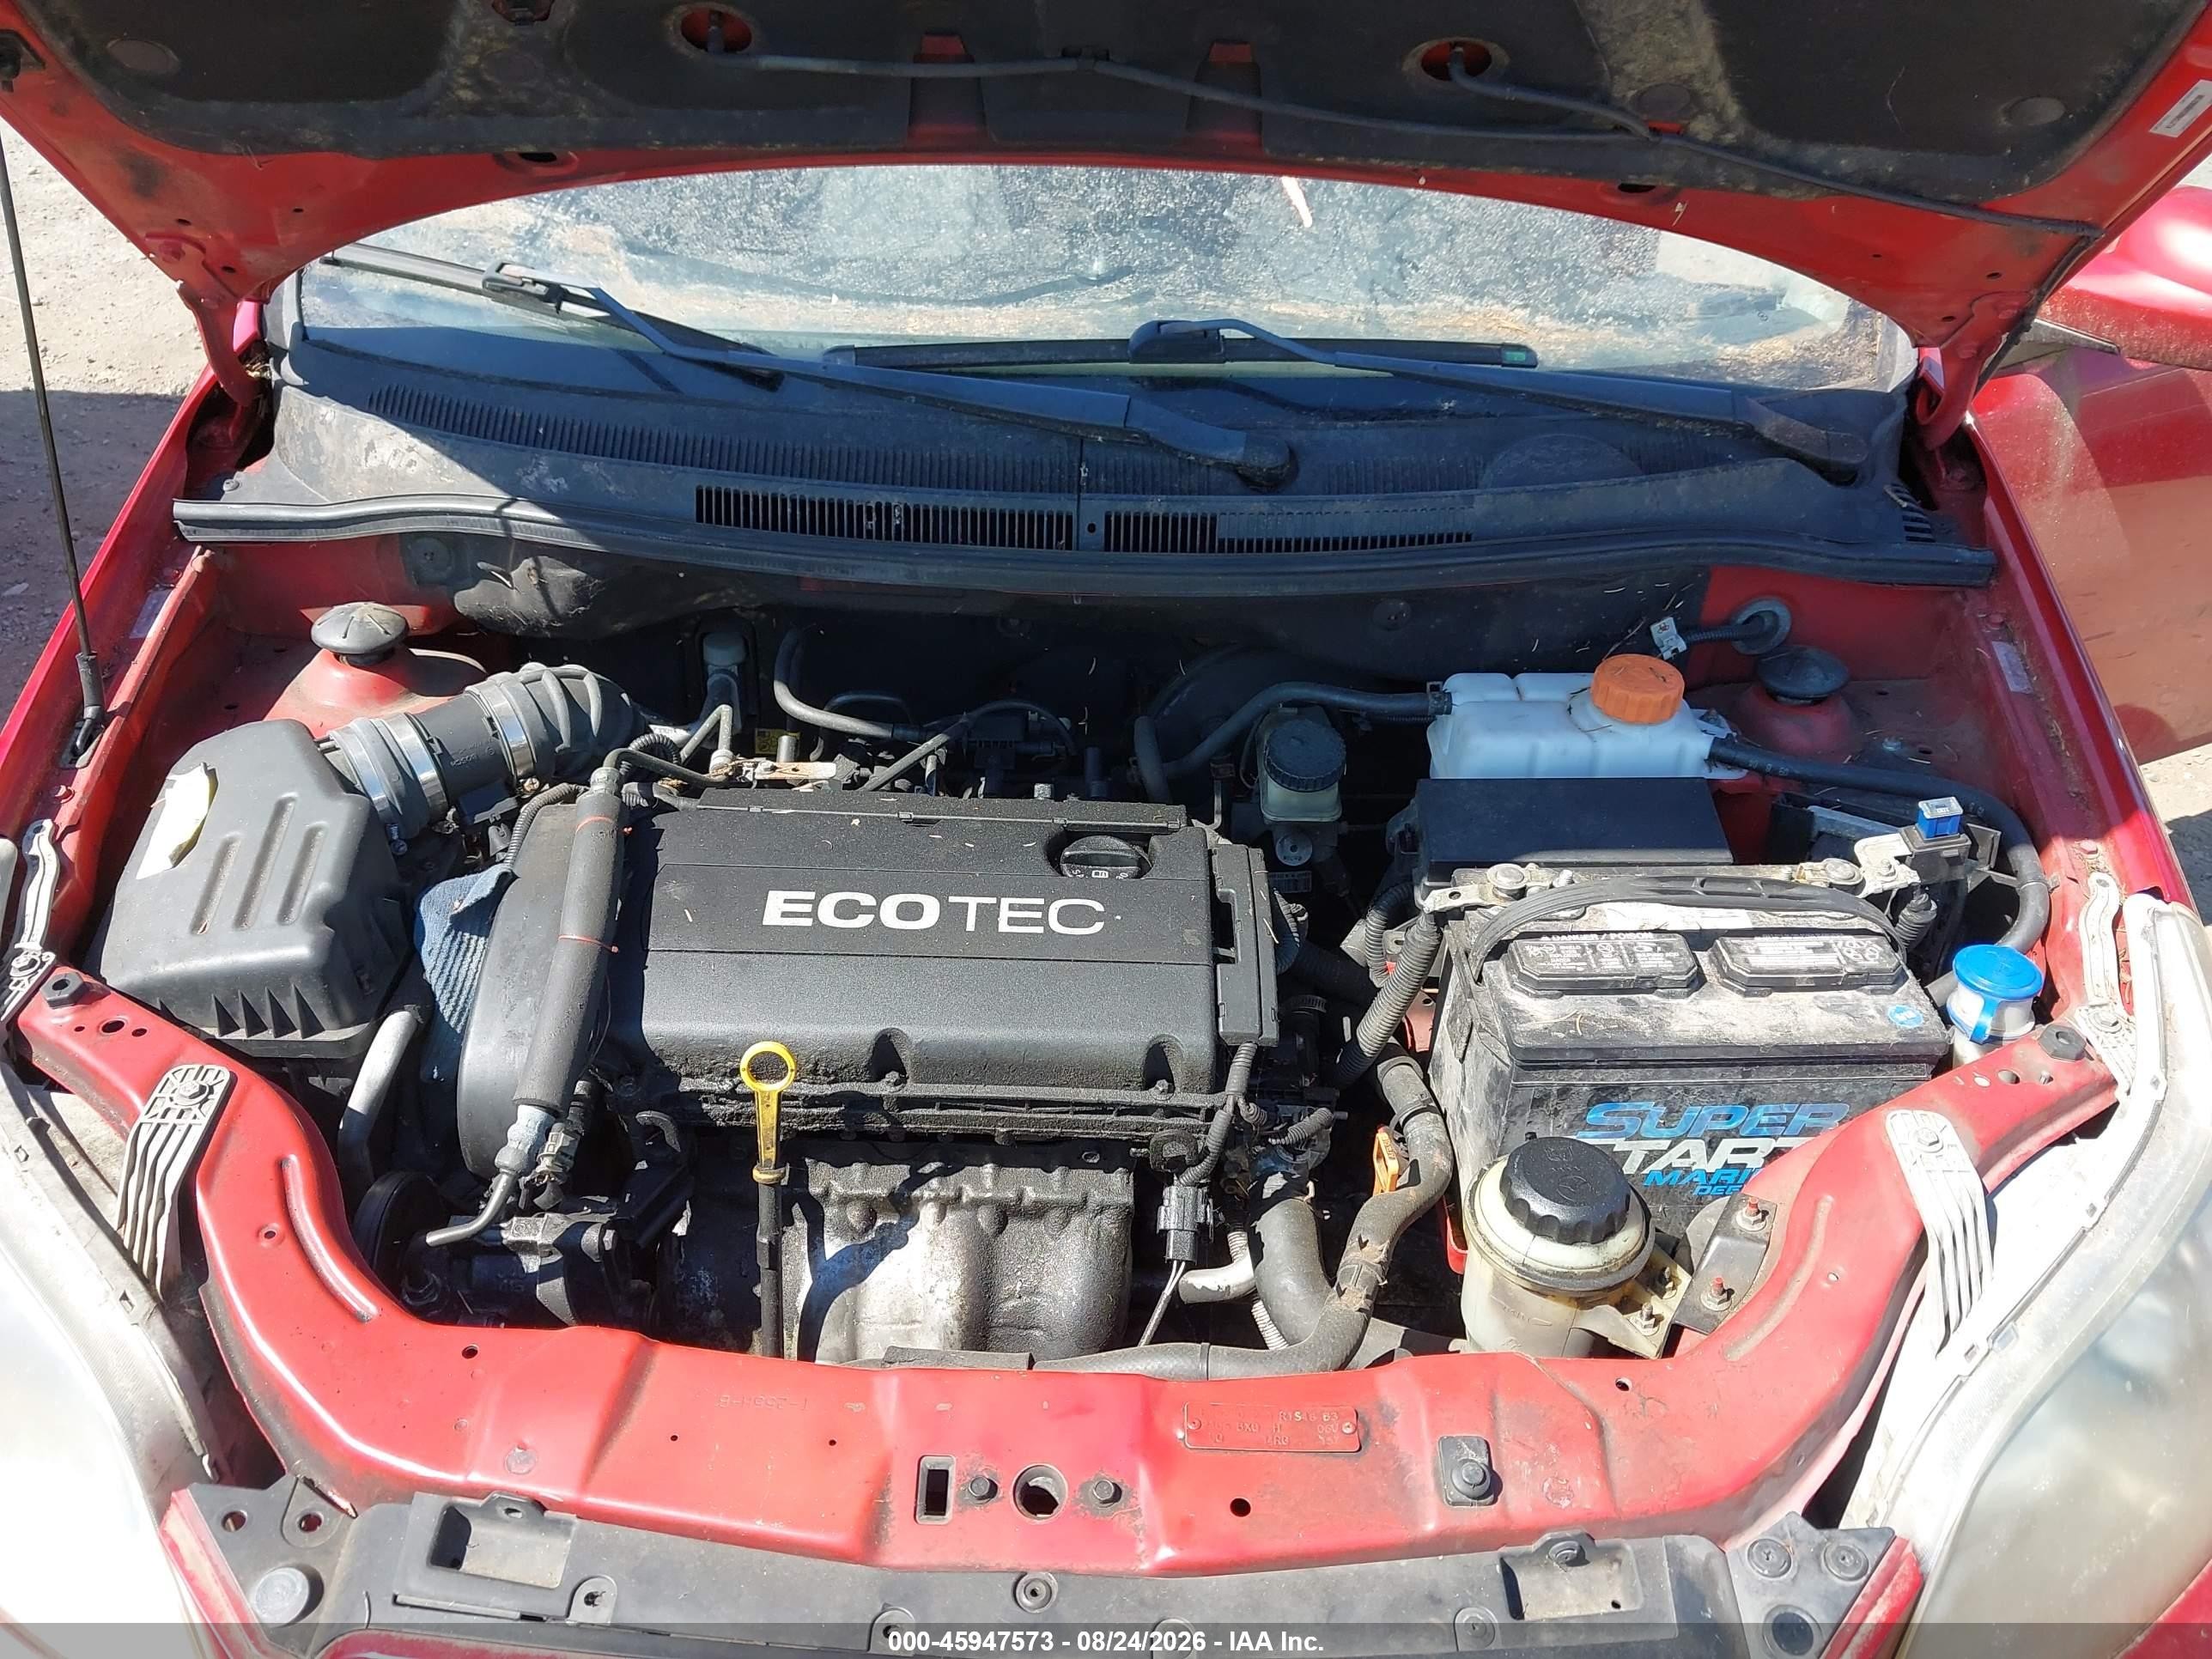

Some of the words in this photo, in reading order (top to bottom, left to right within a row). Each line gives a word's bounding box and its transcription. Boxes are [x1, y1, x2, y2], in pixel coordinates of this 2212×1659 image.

[763, 890, 1105, 935] ECOTEC
[1609, 932, 1654, 940] POISON
[1576, 1101, 1850, 1139] SUPER
